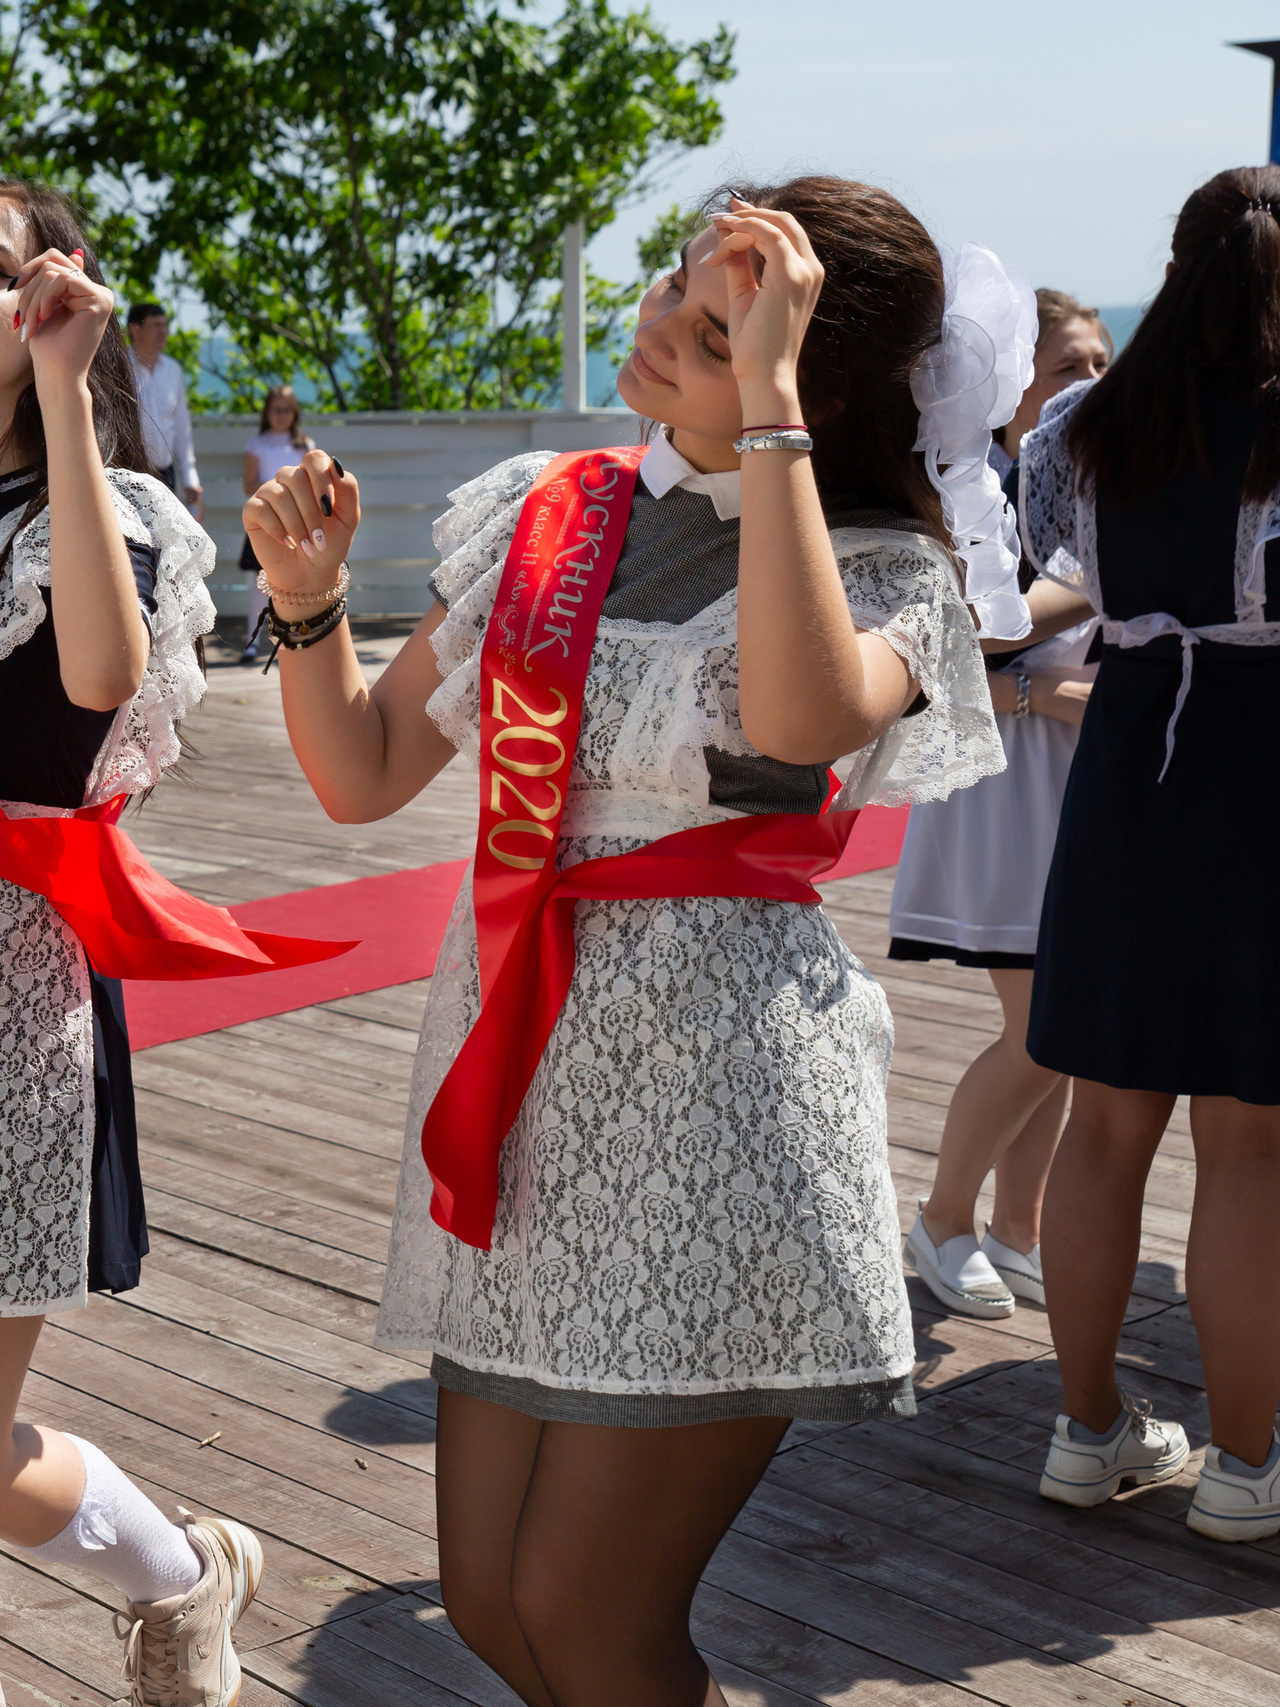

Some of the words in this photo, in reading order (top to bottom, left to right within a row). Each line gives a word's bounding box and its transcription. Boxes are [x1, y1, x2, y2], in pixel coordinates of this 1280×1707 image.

[527, 505, 552, 548] класс
[520, 551, 540, 565] 11
[487, 677, 568, 870] 2020
